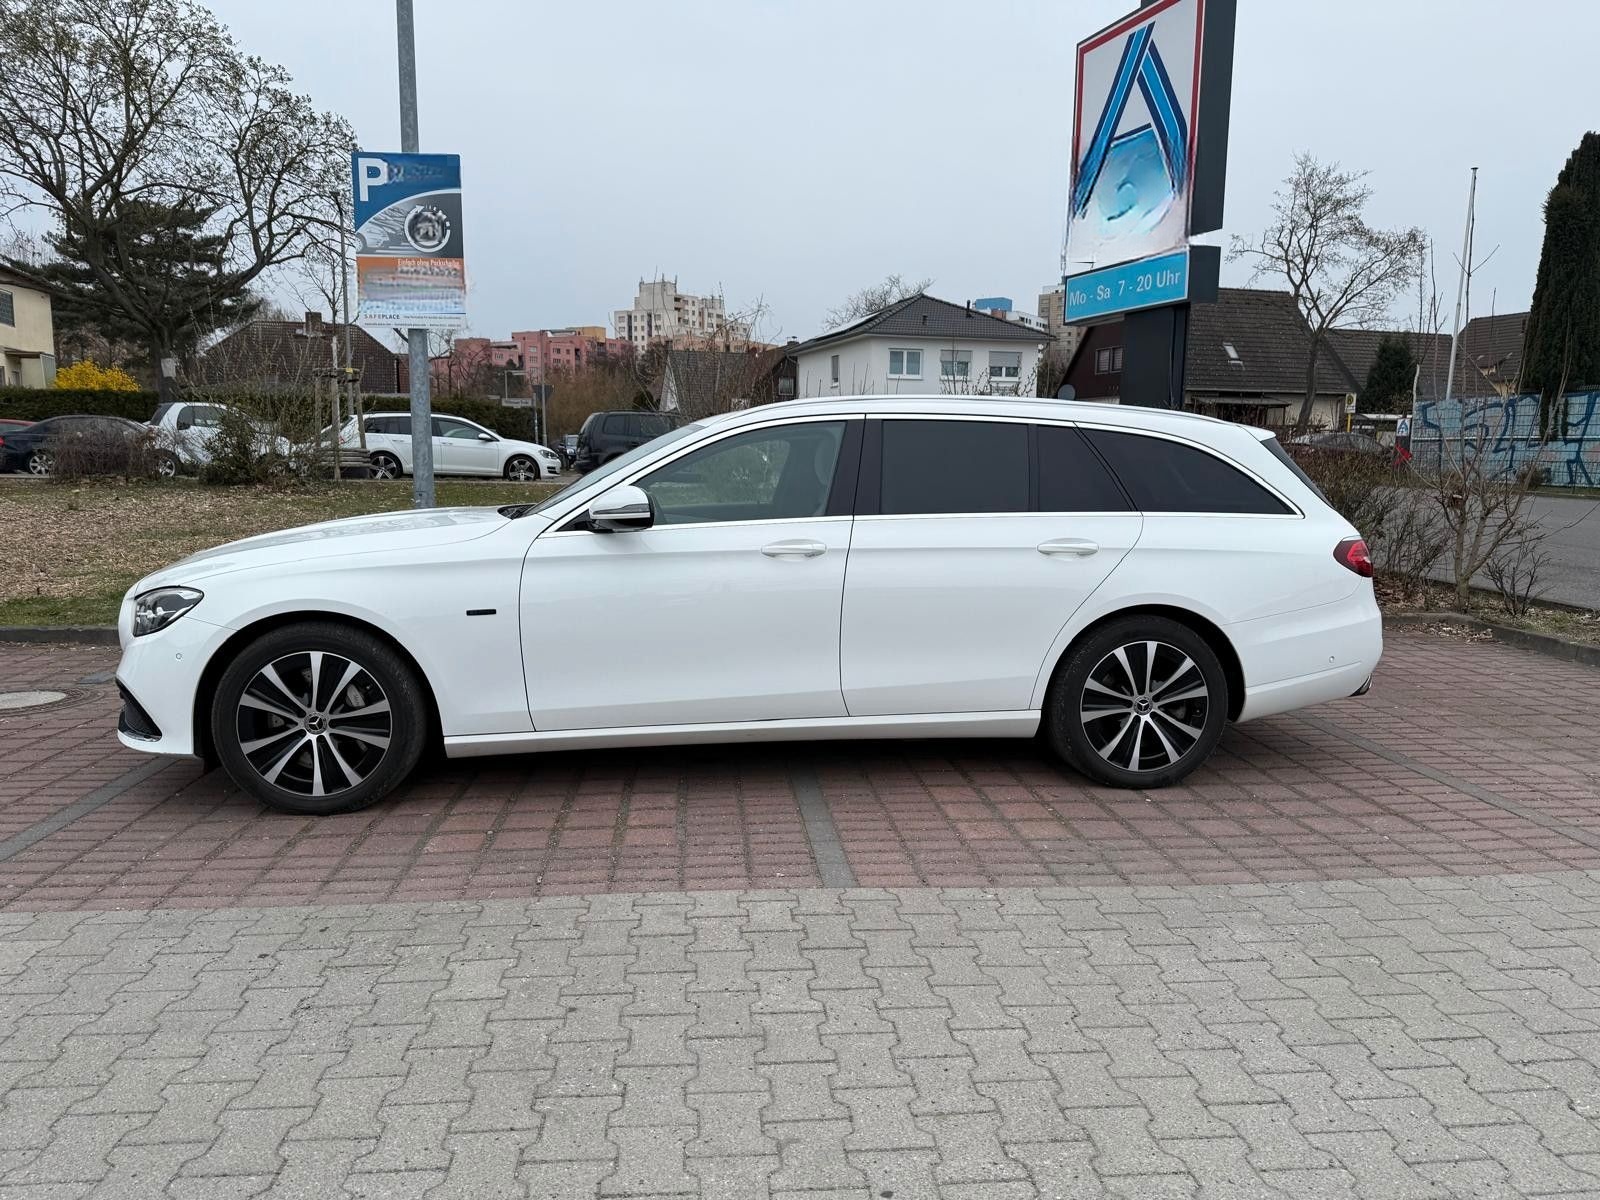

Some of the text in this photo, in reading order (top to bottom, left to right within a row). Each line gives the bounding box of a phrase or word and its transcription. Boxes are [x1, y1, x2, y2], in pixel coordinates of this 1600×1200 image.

[358, 158, 388, 202] P
[430, 258, 460, 268] Parksch
[1069, 291, 1086, 307] Mo
[1096, 285, 1111, 301] Sa
[1118, 280, 1125, 297] 7
[1136, 274, 1152, 293] 20
[1156, 270, 1181, 288] Uhr
